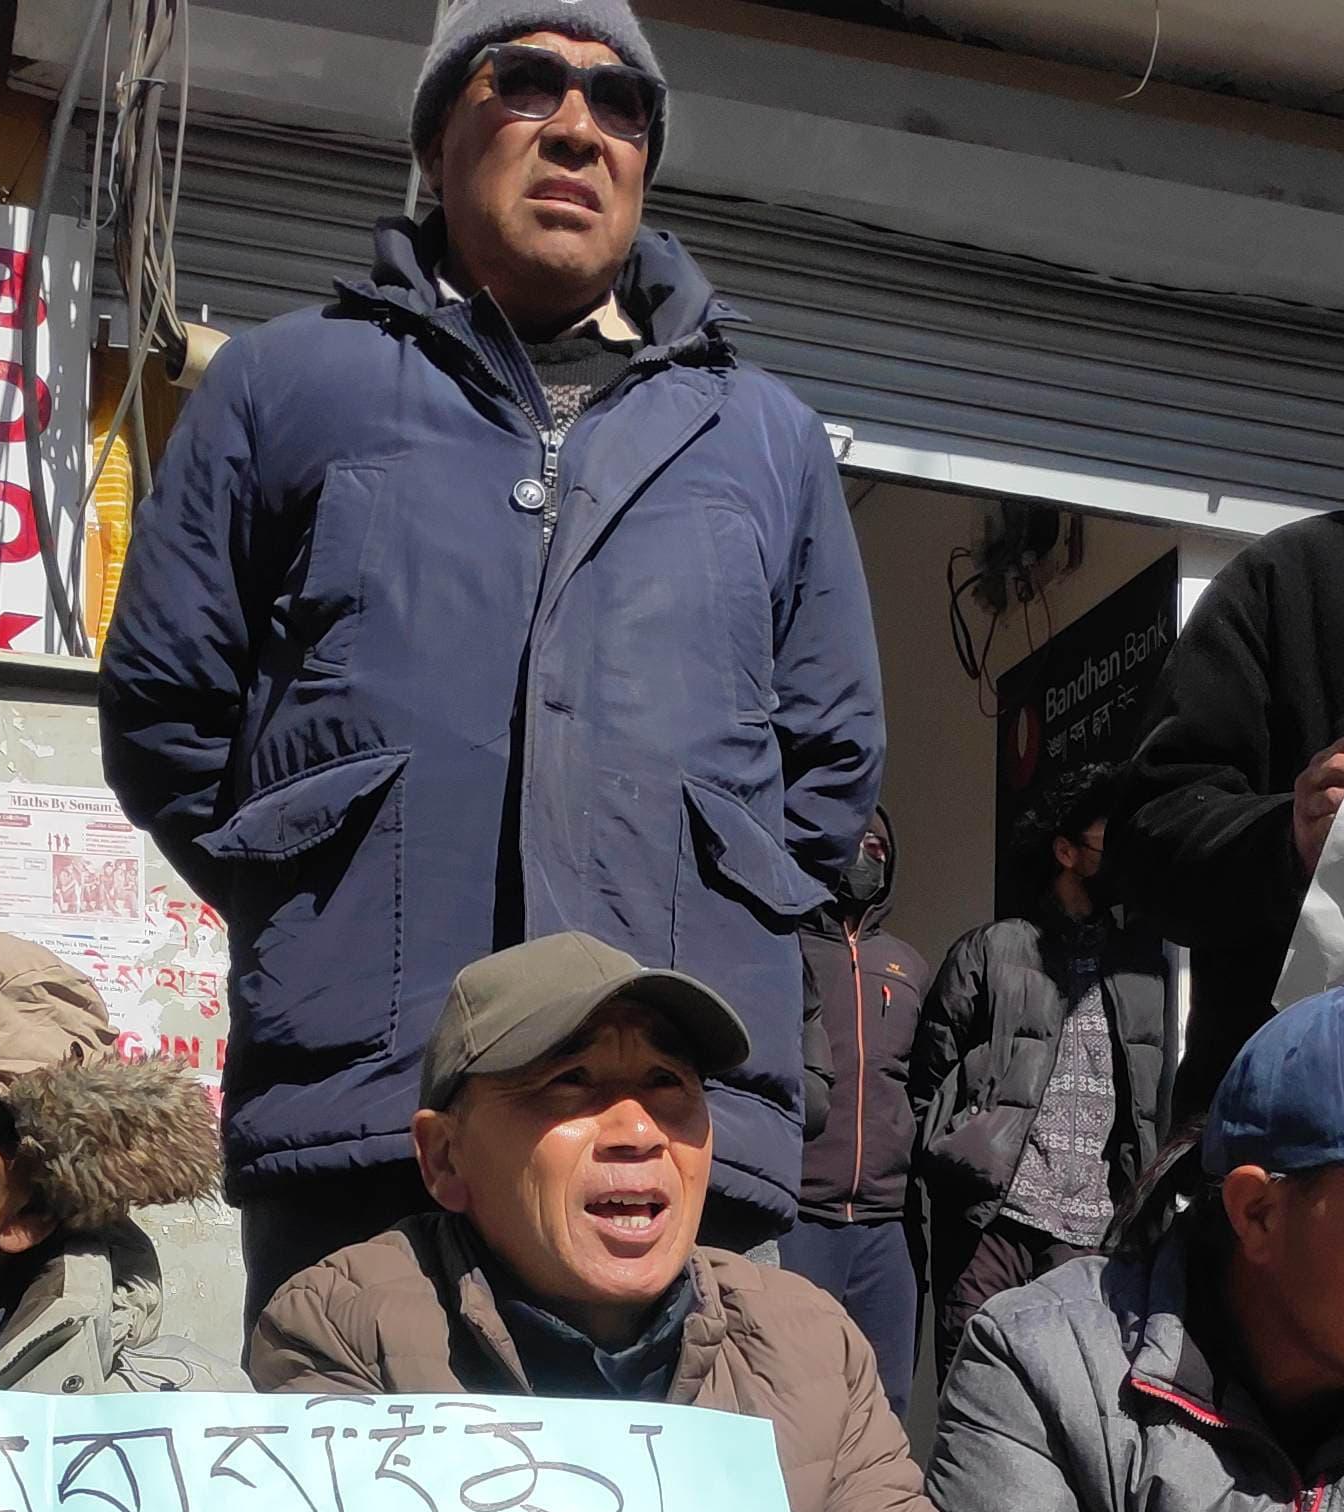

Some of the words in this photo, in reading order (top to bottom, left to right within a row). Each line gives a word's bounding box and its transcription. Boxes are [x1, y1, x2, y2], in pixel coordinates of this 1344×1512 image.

[1045, 651, 1121, 724] Bandhan
[1124, 609, 1168, 671] Bank
[9, 794, 50, 809] Maths
[51, 797, 67, 813] By
[68, 798, 114, 813] Sonam
